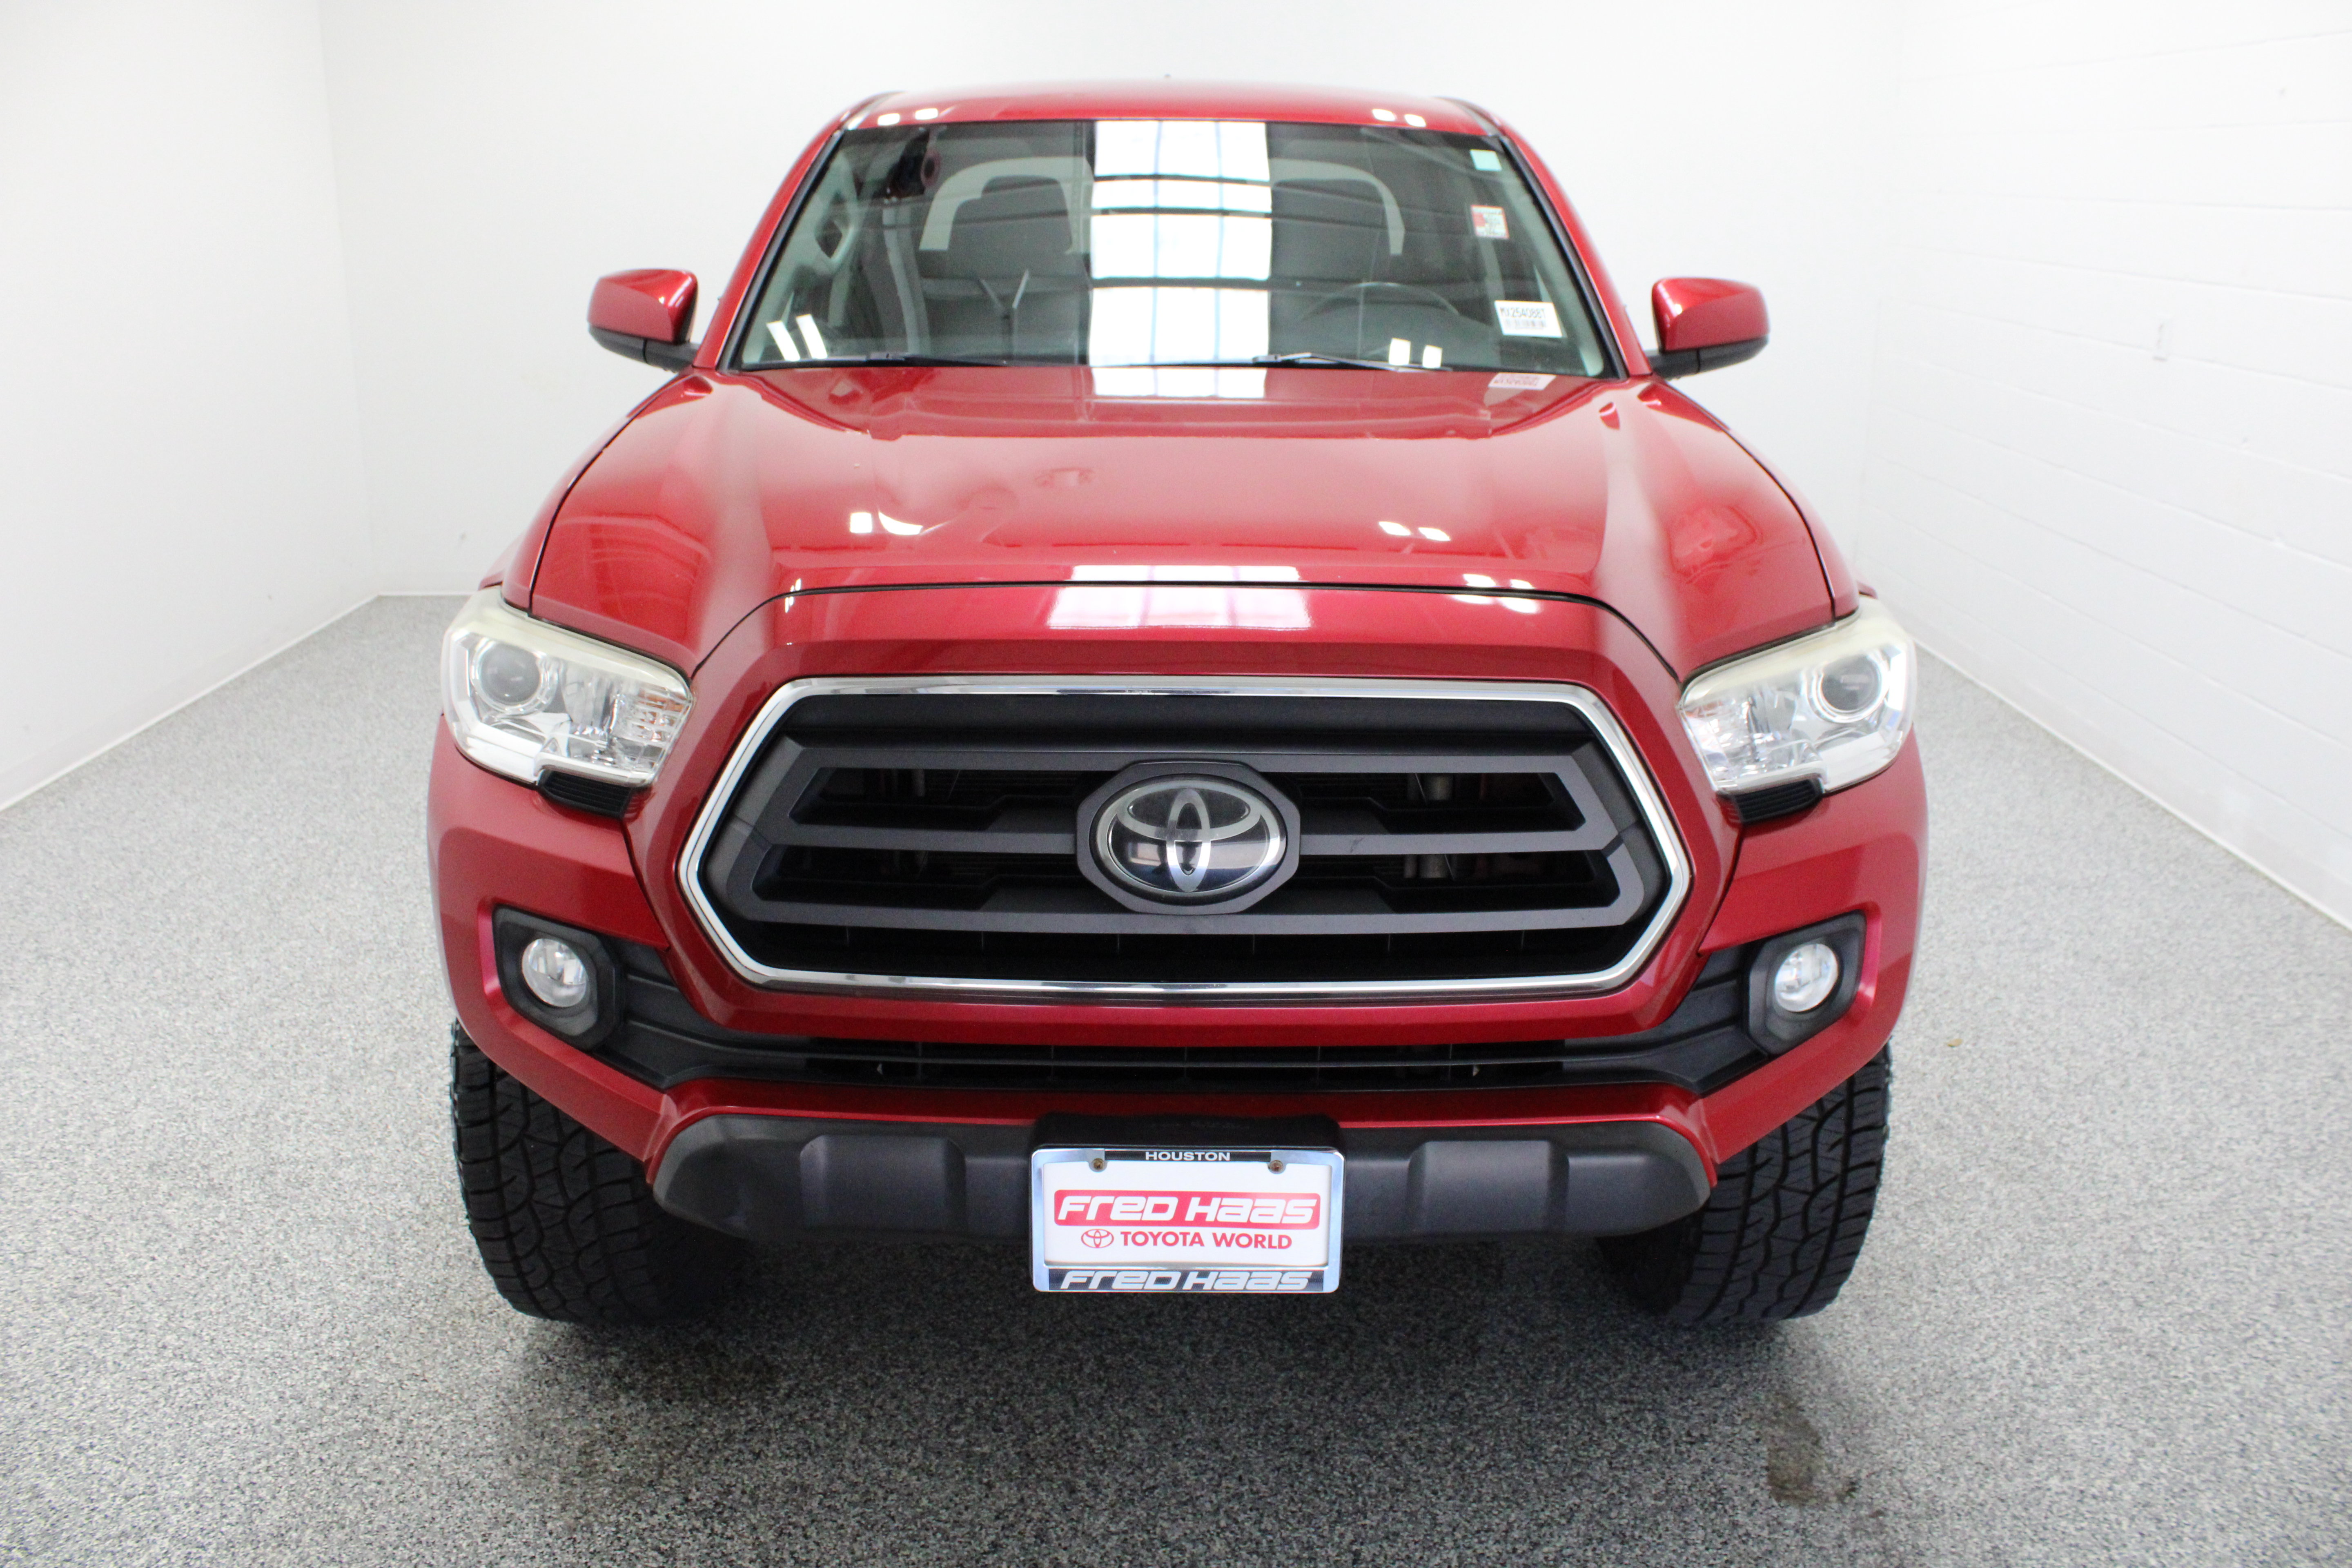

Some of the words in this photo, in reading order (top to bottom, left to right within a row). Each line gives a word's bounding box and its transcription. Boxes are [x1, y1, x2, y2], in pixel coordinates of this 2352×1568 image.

[1145, 1152, 1230, 1161] HOUSTON
[1120, 1231, 1205, 1247] TOYOTA
[1212, 1232, 1292, 1250] WORLD
